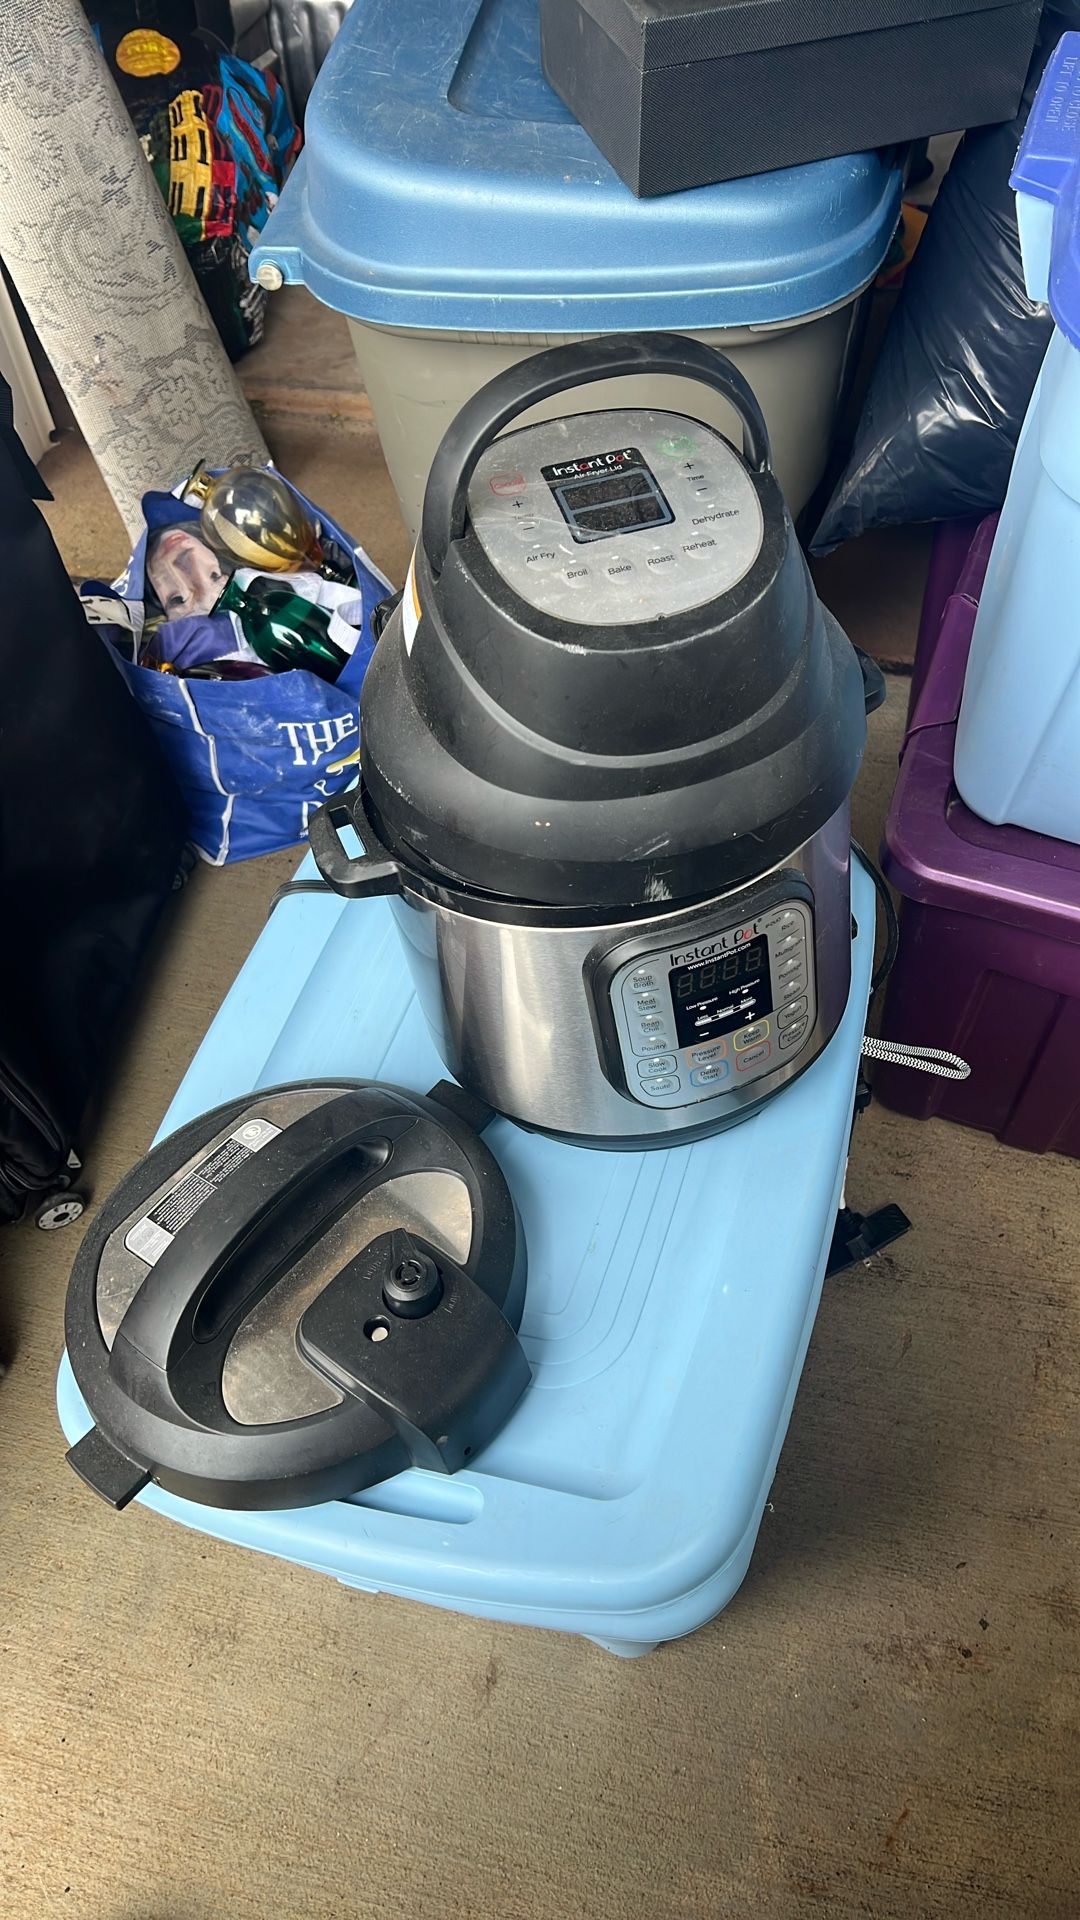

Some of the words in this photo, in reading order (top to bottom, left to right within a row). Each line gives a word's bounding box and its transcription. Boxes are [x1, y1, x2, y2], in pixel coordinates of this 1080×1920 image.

[1060, 56, 1078, 77] LIFT
[1054, 81, 1070, 92] TO
[1045, 97, 1064, 123] OPEN
[552, 457, 605, 476] Instant
[587, 468, 608, 476] Fryer
[610, 464, 623, 472] Lid
[692, 509, 740, 526] Dehydrate
[682, 539, 717, 553] Reheat
[526, 553, 538, 563] Air
[539, 551, 556, 562] Fry
[647, 553, 675, 566] Roast
[567, 568, 588, 579] Broil
[608, 563, 632, 575] Bake
[278, 712, 358, 766] THE
[669, 937, 729, 967] Instant
[633, 975, 653, 983] Soup
[728, 986, 740, 995] High
[741, 978, 760, 990] Pressure
[637, 998, 656, 1006] Meat
[686, 1003, 697, 1011] Low
[743, 1028, 761, 1039] Keep
[691, 1045, 721, 1058] Pressure
[698, 1053, 717, 1062] Level
[743, 1050, 765, 1063] Cancel
[648, 1061, 666, 1069] Slow
[700, 1066, 720, 1077] Delay
[703, 1073, 719, 1081] Start
